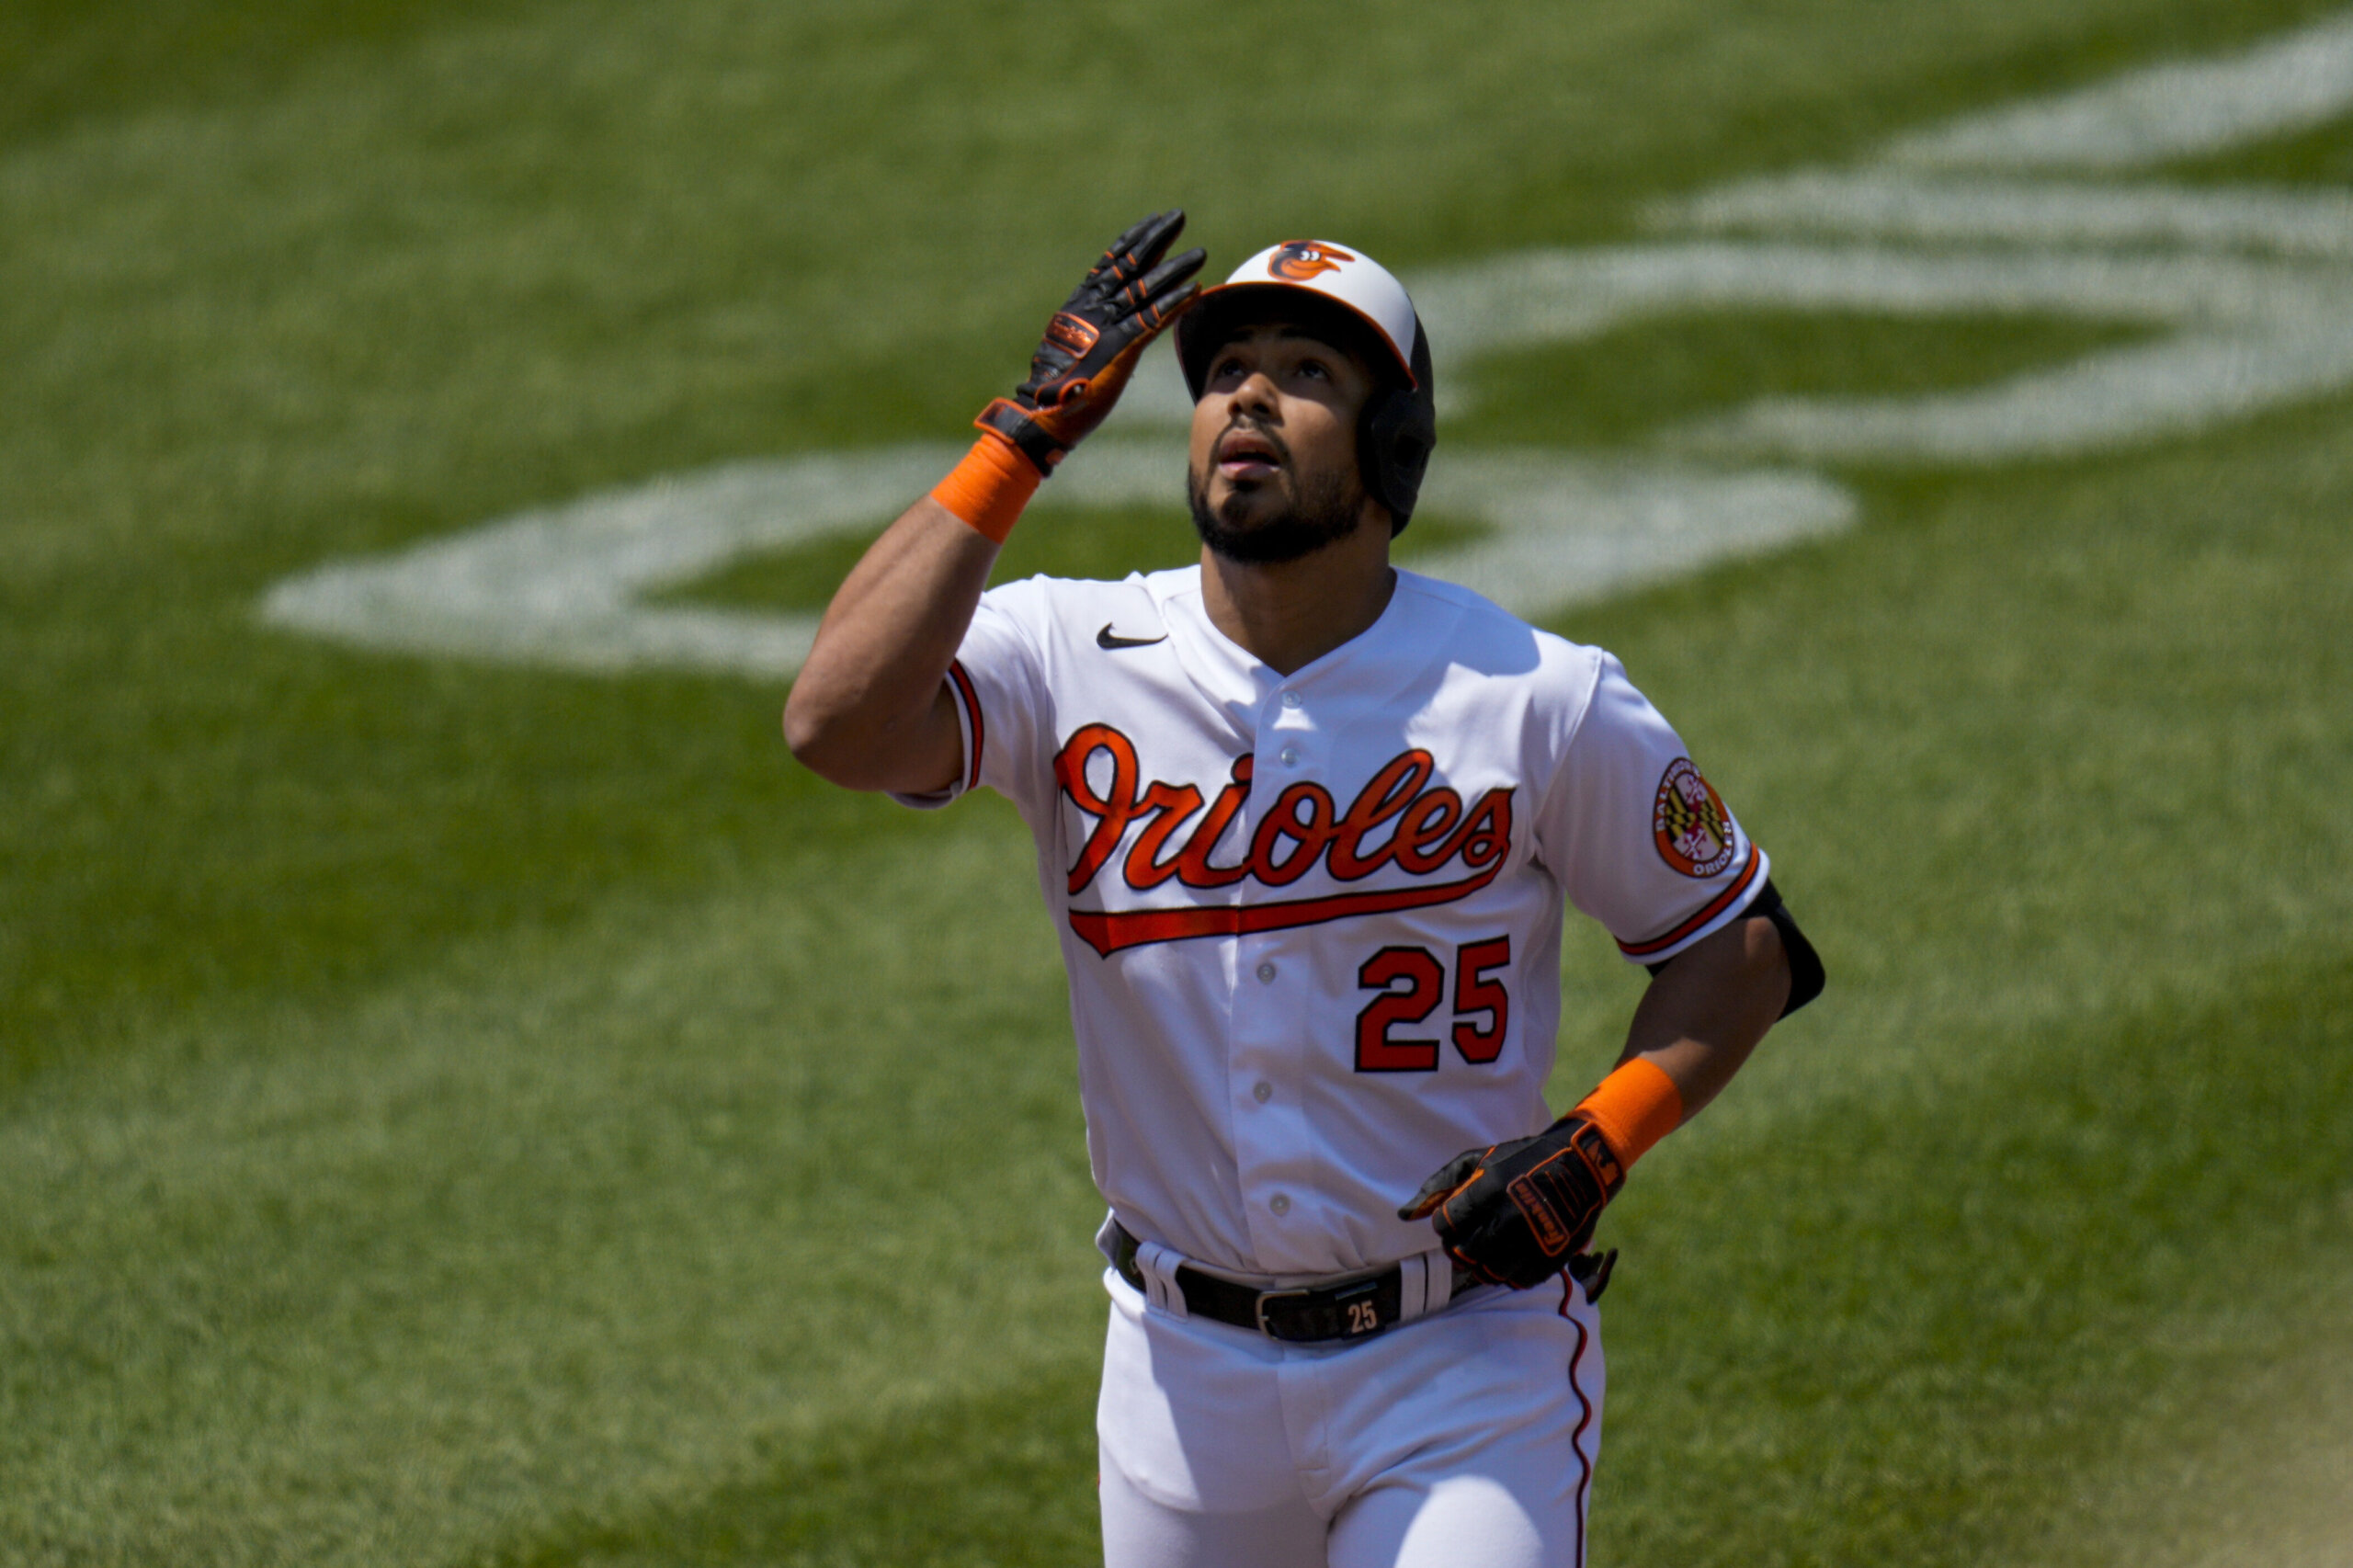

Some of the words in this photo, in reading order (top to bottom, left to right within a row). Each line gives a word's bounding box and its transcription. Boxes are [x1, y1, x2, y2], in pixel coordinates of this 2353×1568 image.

[1053, 722, 1518, 895] Orioles
[1693, 820, 1733, 876] ORIOLES
[1354, 934, 1510, 1073] 25
[1347, 1300, 1378, 1334] 25
